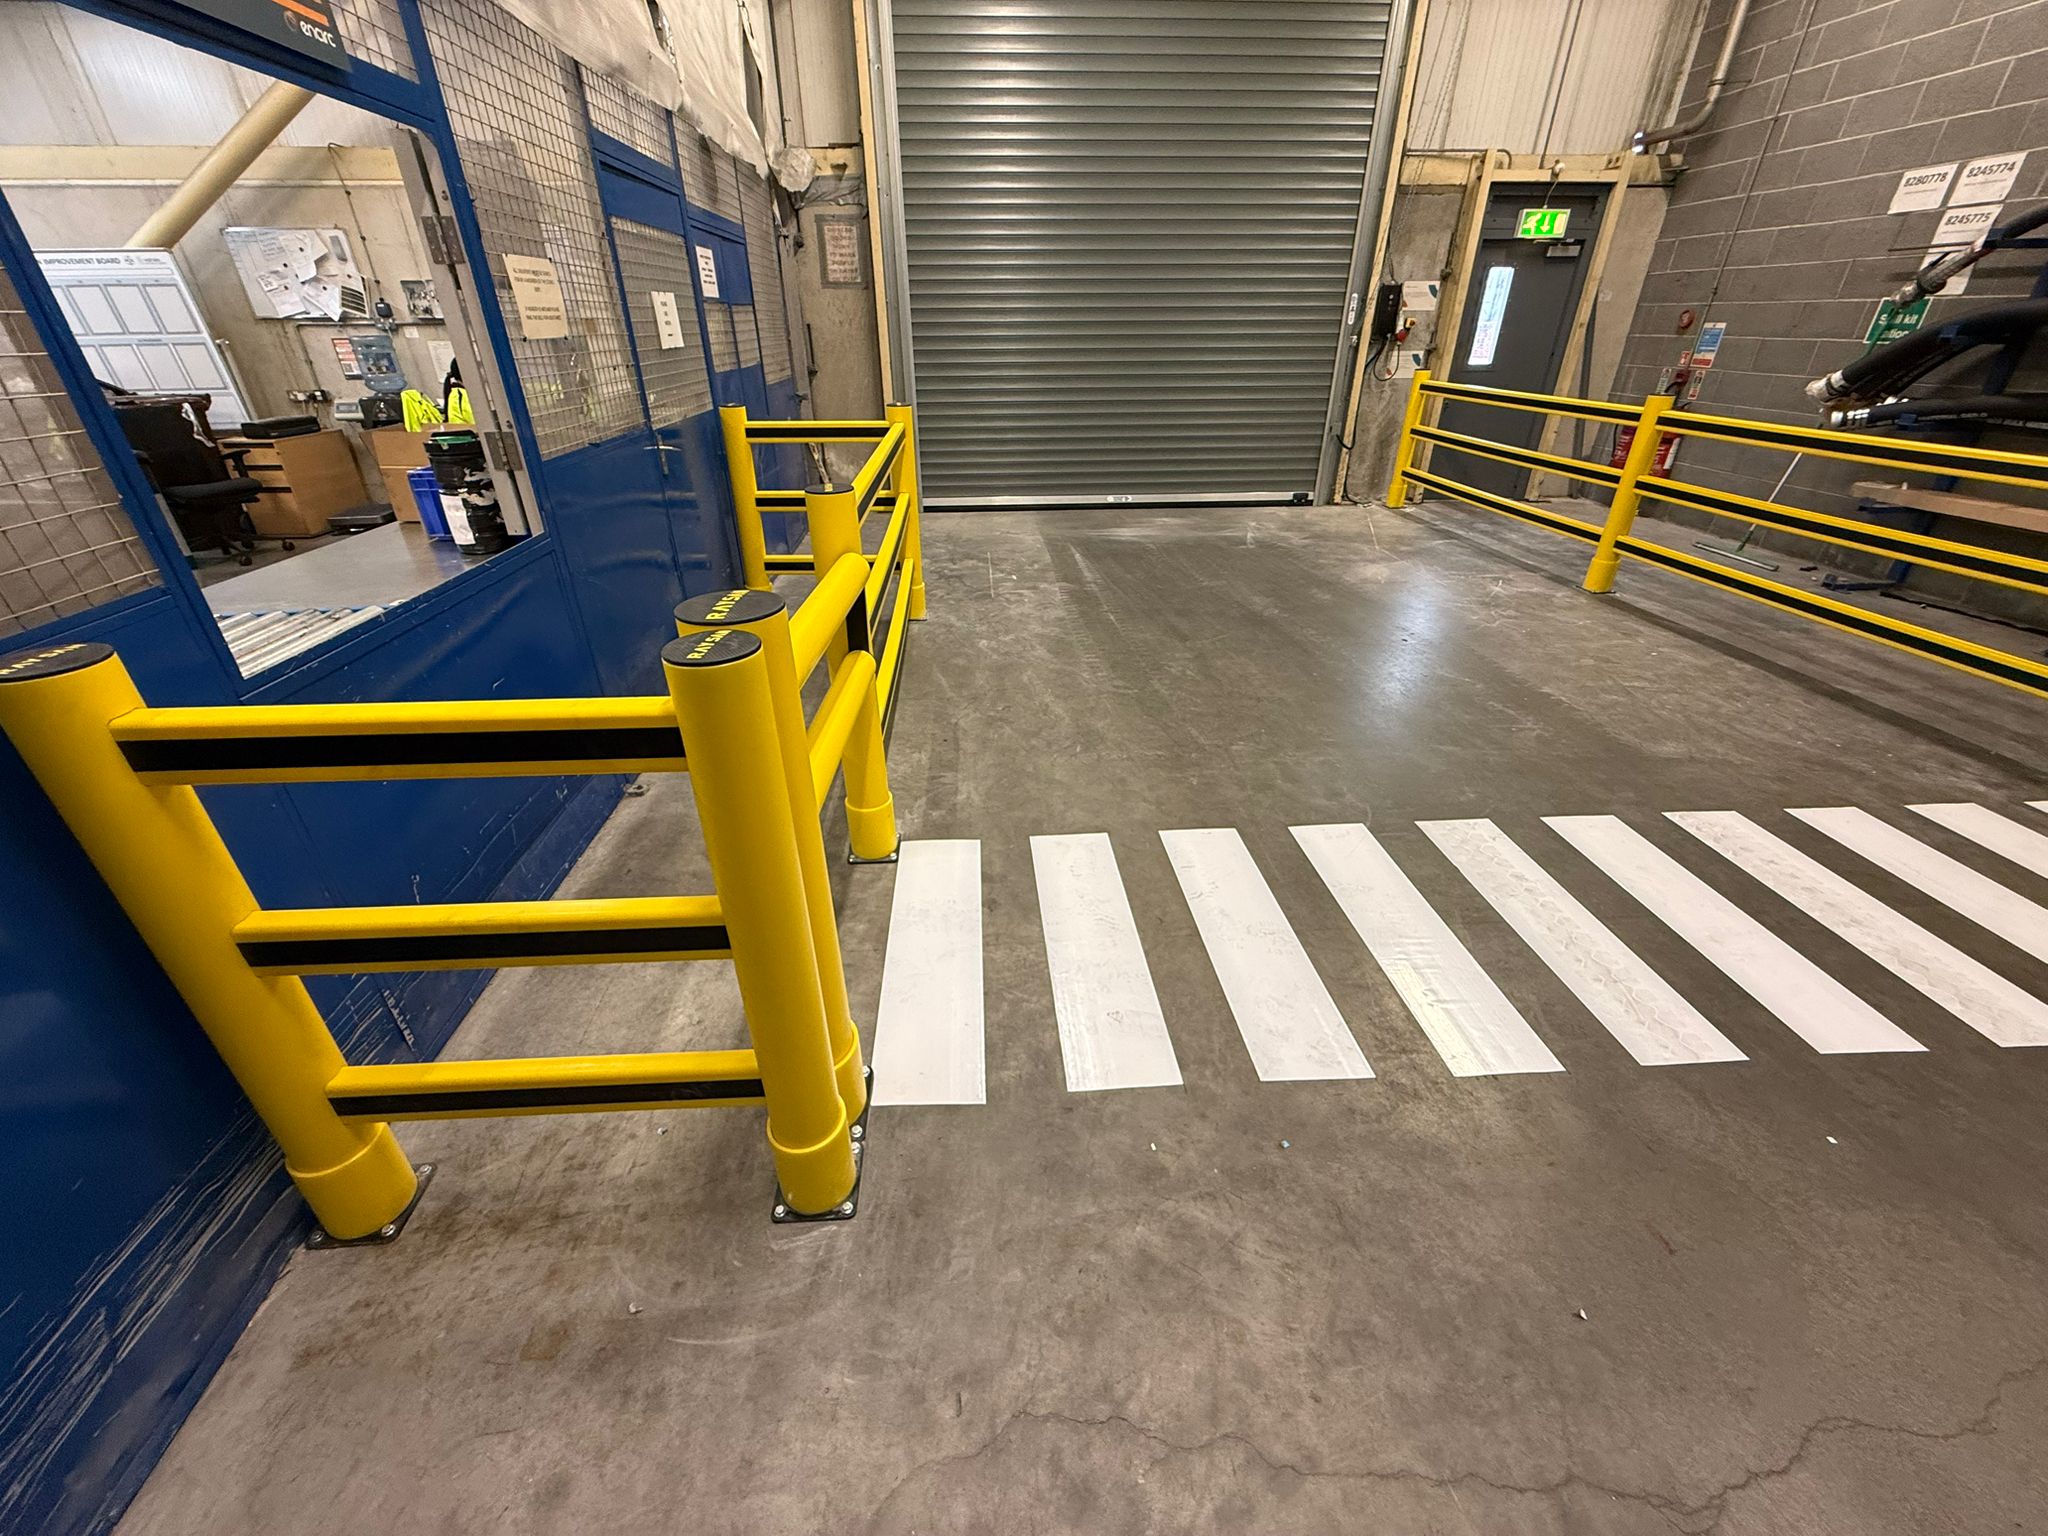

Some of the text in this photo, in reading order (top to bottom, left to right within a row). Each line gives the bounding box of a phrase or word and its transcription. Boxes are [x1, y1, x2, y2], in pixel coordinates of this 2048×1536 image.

[299, 20, 337, 48] enarc
[1966, 161, 2016, 178] 8245774
[1903, 171, 1949, 187] 8280778
[1944, 212, 1993, 226] 8245775
[44, 257, 95, 265] IMPROVEMENT
[96, 257, 121, 265] BOARD
